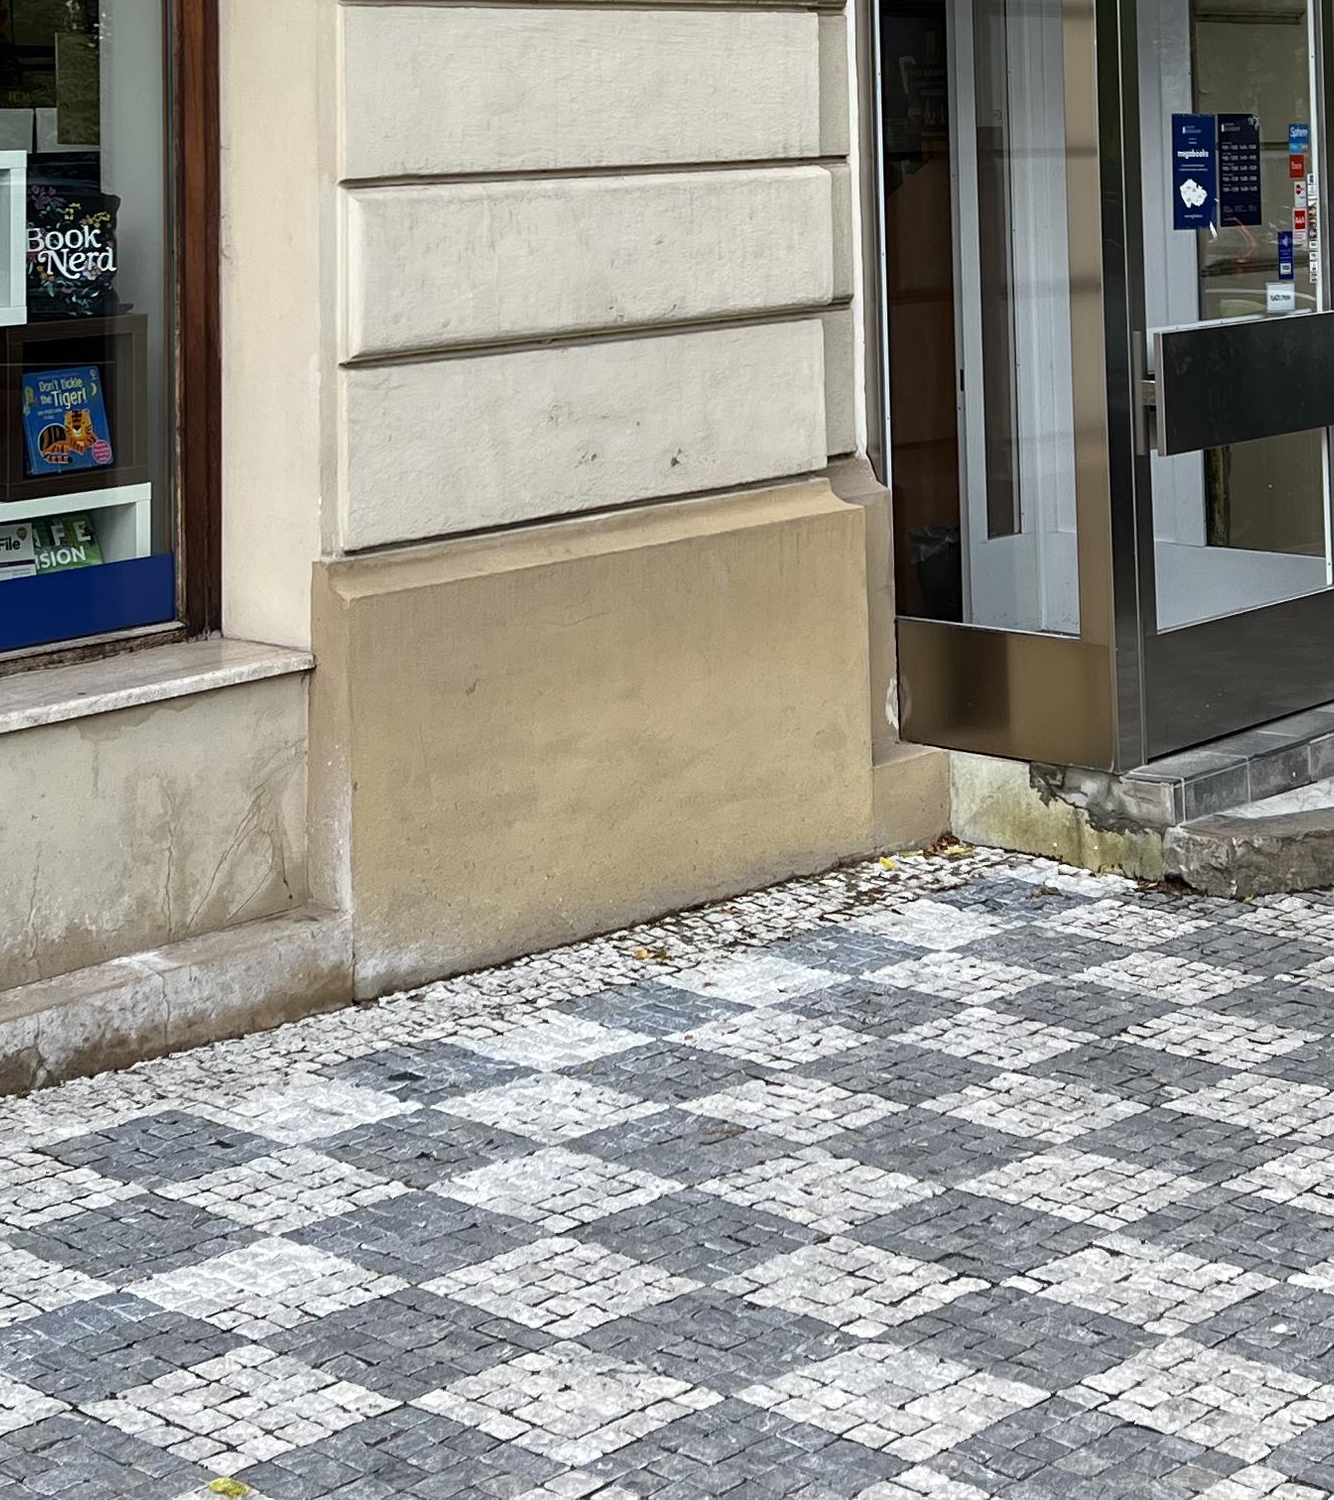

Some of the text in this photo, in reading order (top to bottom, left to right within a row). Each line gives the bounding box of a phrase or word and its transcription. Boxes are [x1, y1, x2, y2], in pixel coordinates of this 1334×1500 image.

[26, 225, 102, 252] Book
[37, 247, 117, 279] Nerd
[34, 546, 87, 570] ISION
